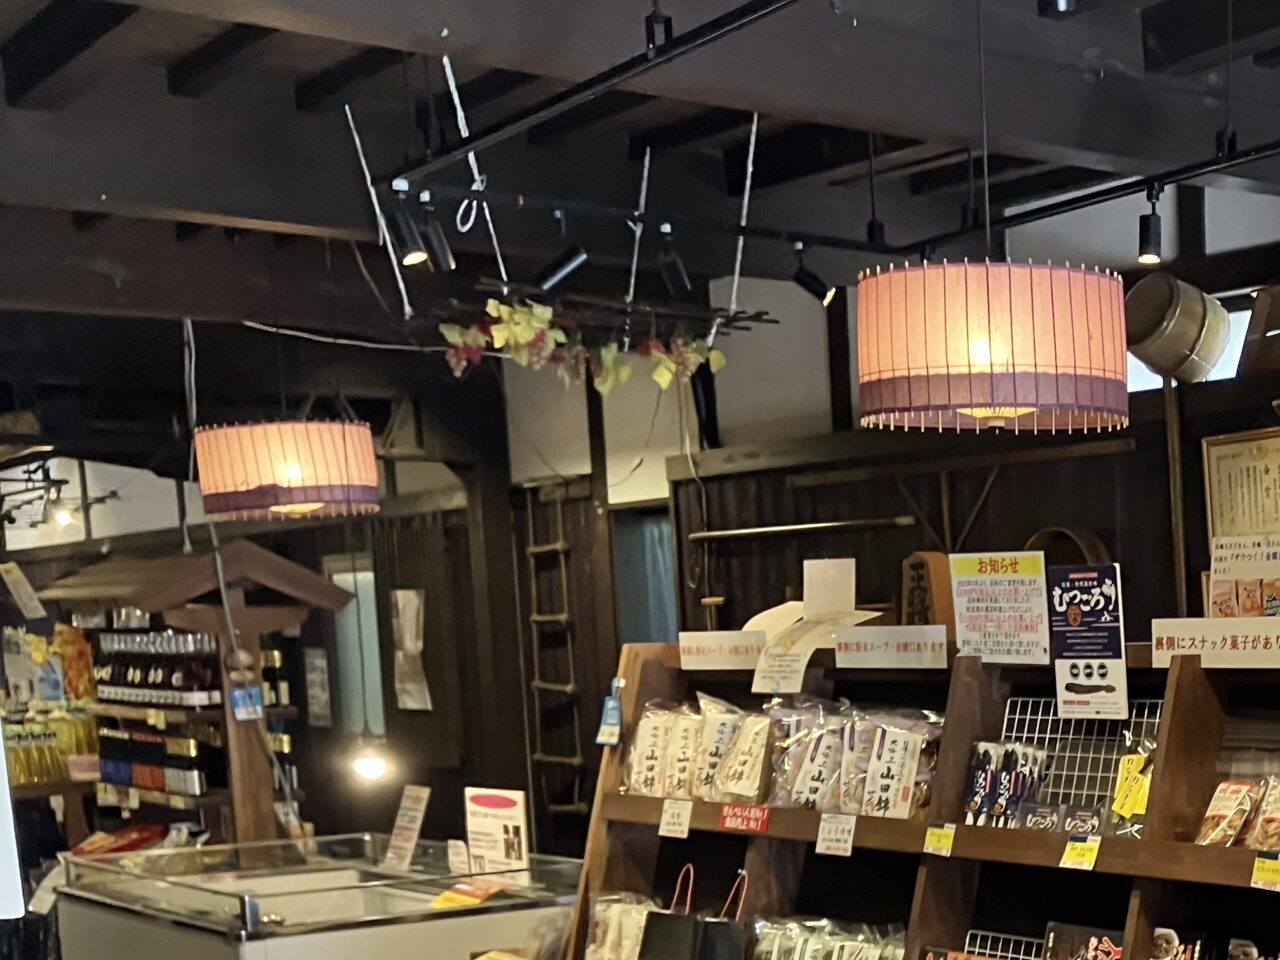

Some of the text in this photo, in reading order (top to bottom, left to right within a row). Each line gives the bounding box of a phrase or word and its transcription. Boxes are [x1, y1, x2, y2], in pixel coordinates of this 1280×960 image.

[977, 557, 1019, 574] お知らせ
[1052, 578, 1117, 612] むつごろう
